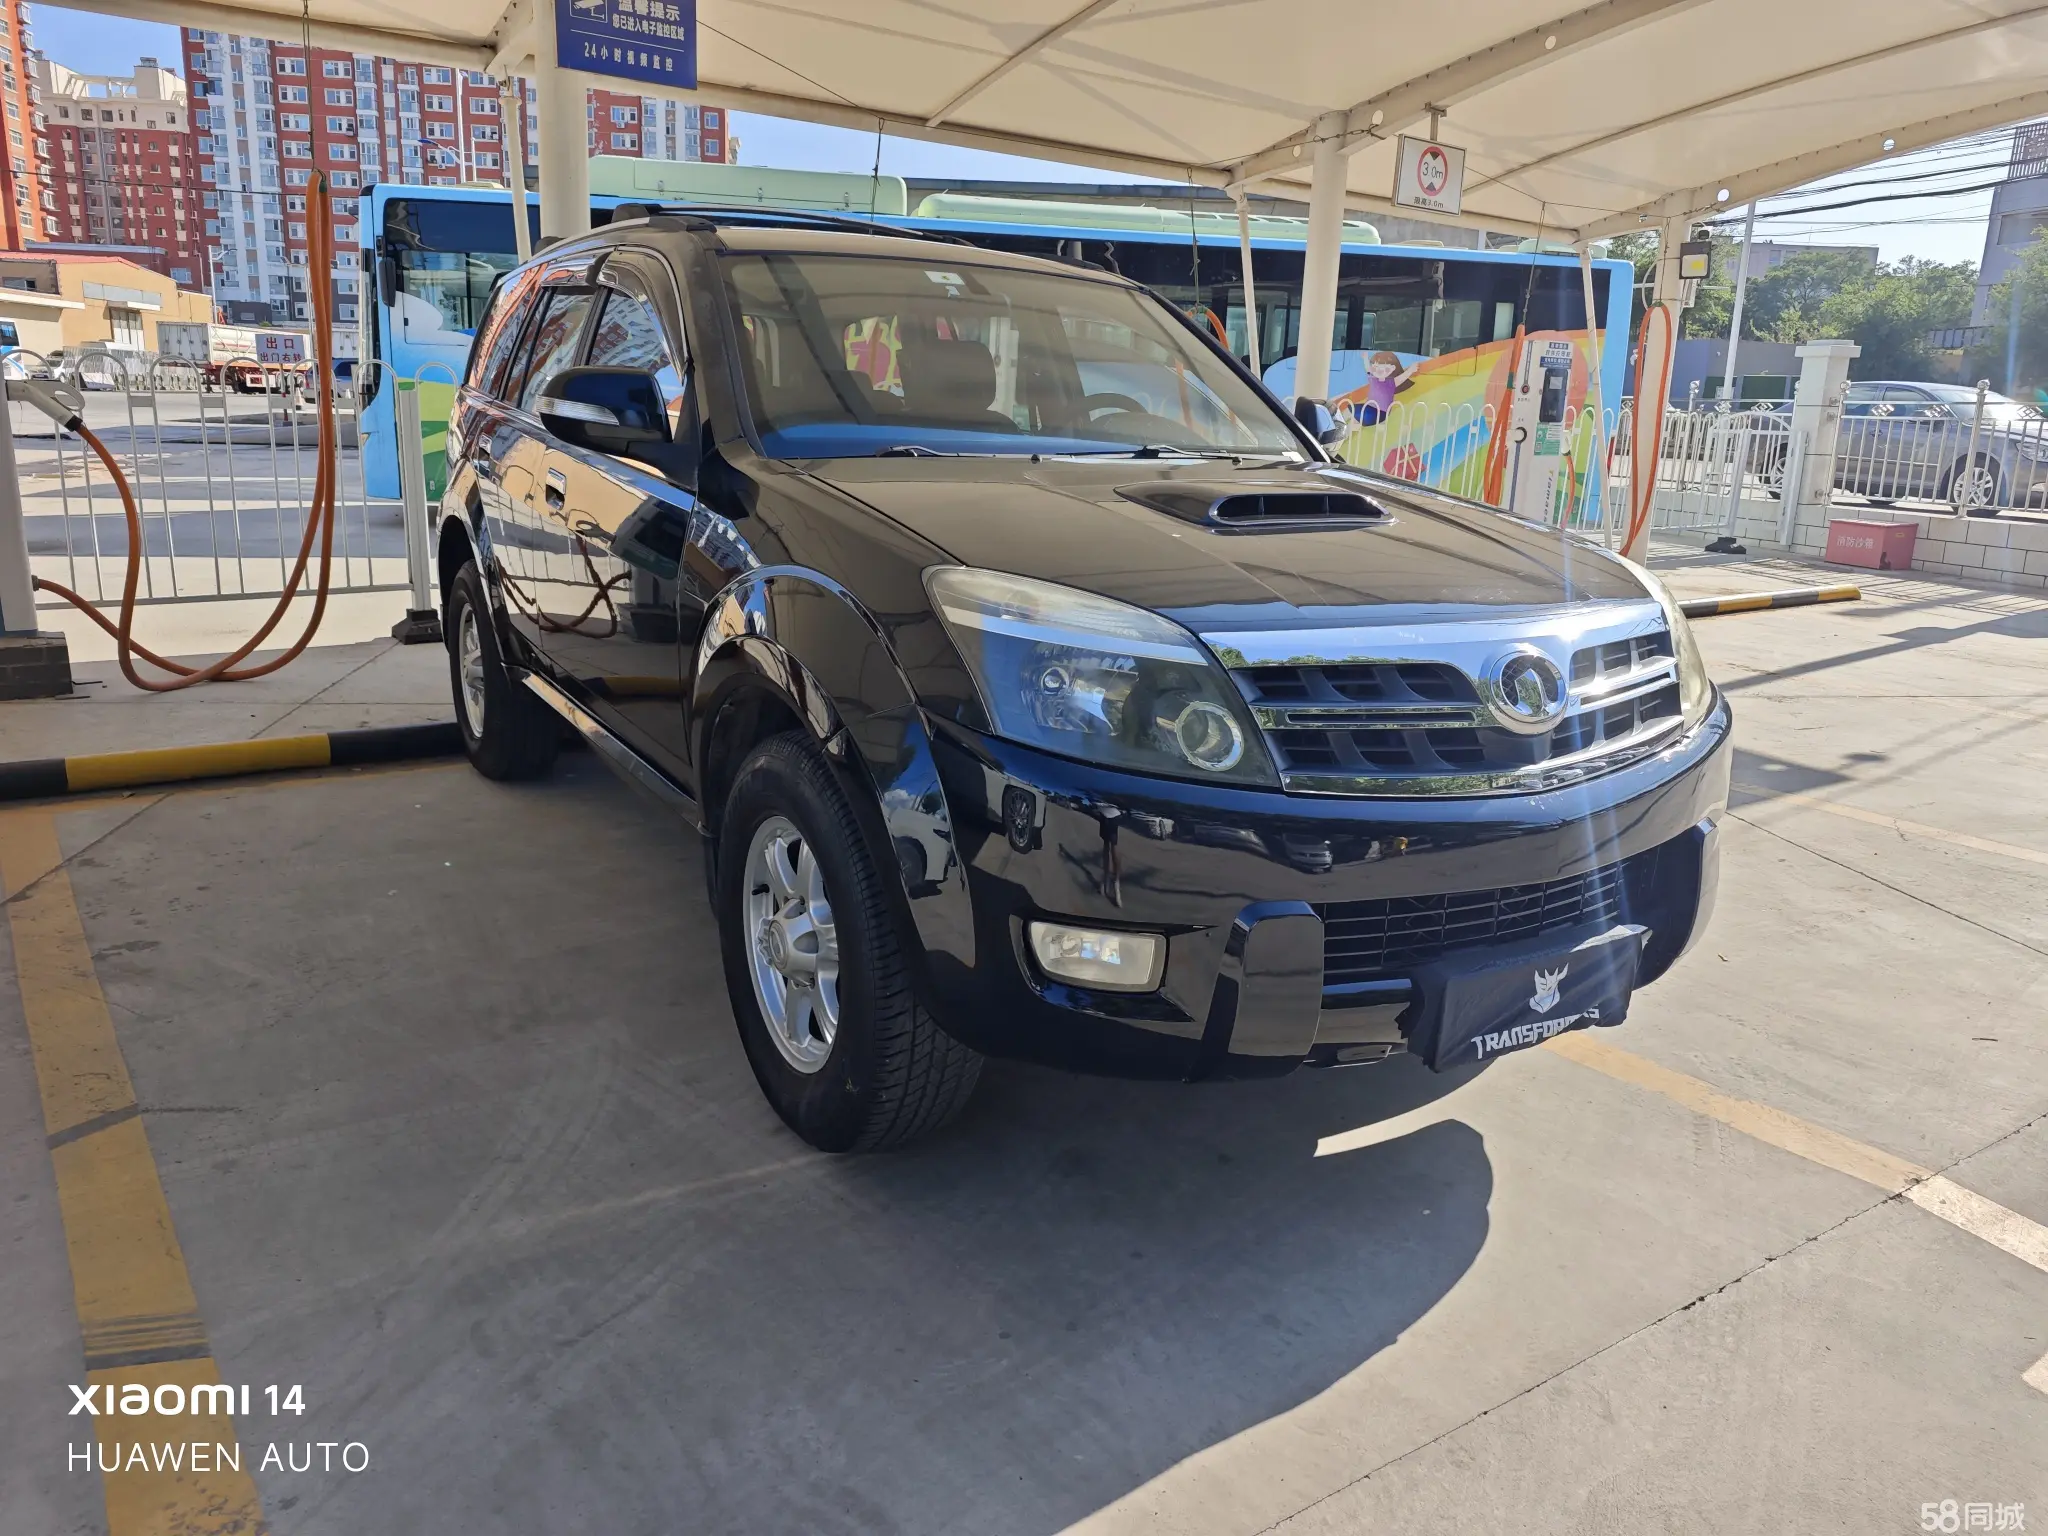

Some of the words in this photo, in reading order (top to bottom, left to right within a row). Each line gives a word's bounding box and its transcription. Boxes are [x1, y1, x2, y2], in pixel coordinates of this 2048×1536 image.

[618, 0, 680, 21] 温馨提示
[612, 13, 685, 41] 您已进入电子监控区域
[584, 42, 674, 72] 24小时视频监控
[1422, 161, 1444, 179] 3.0m
[266, 336, 295, 350] 出口
[260, 352, 302, 362] 出门右转
[1836, 535, 1874, 550] 消防沙箱
[1470, 1004, 1600, 1060] TRANSFORS
